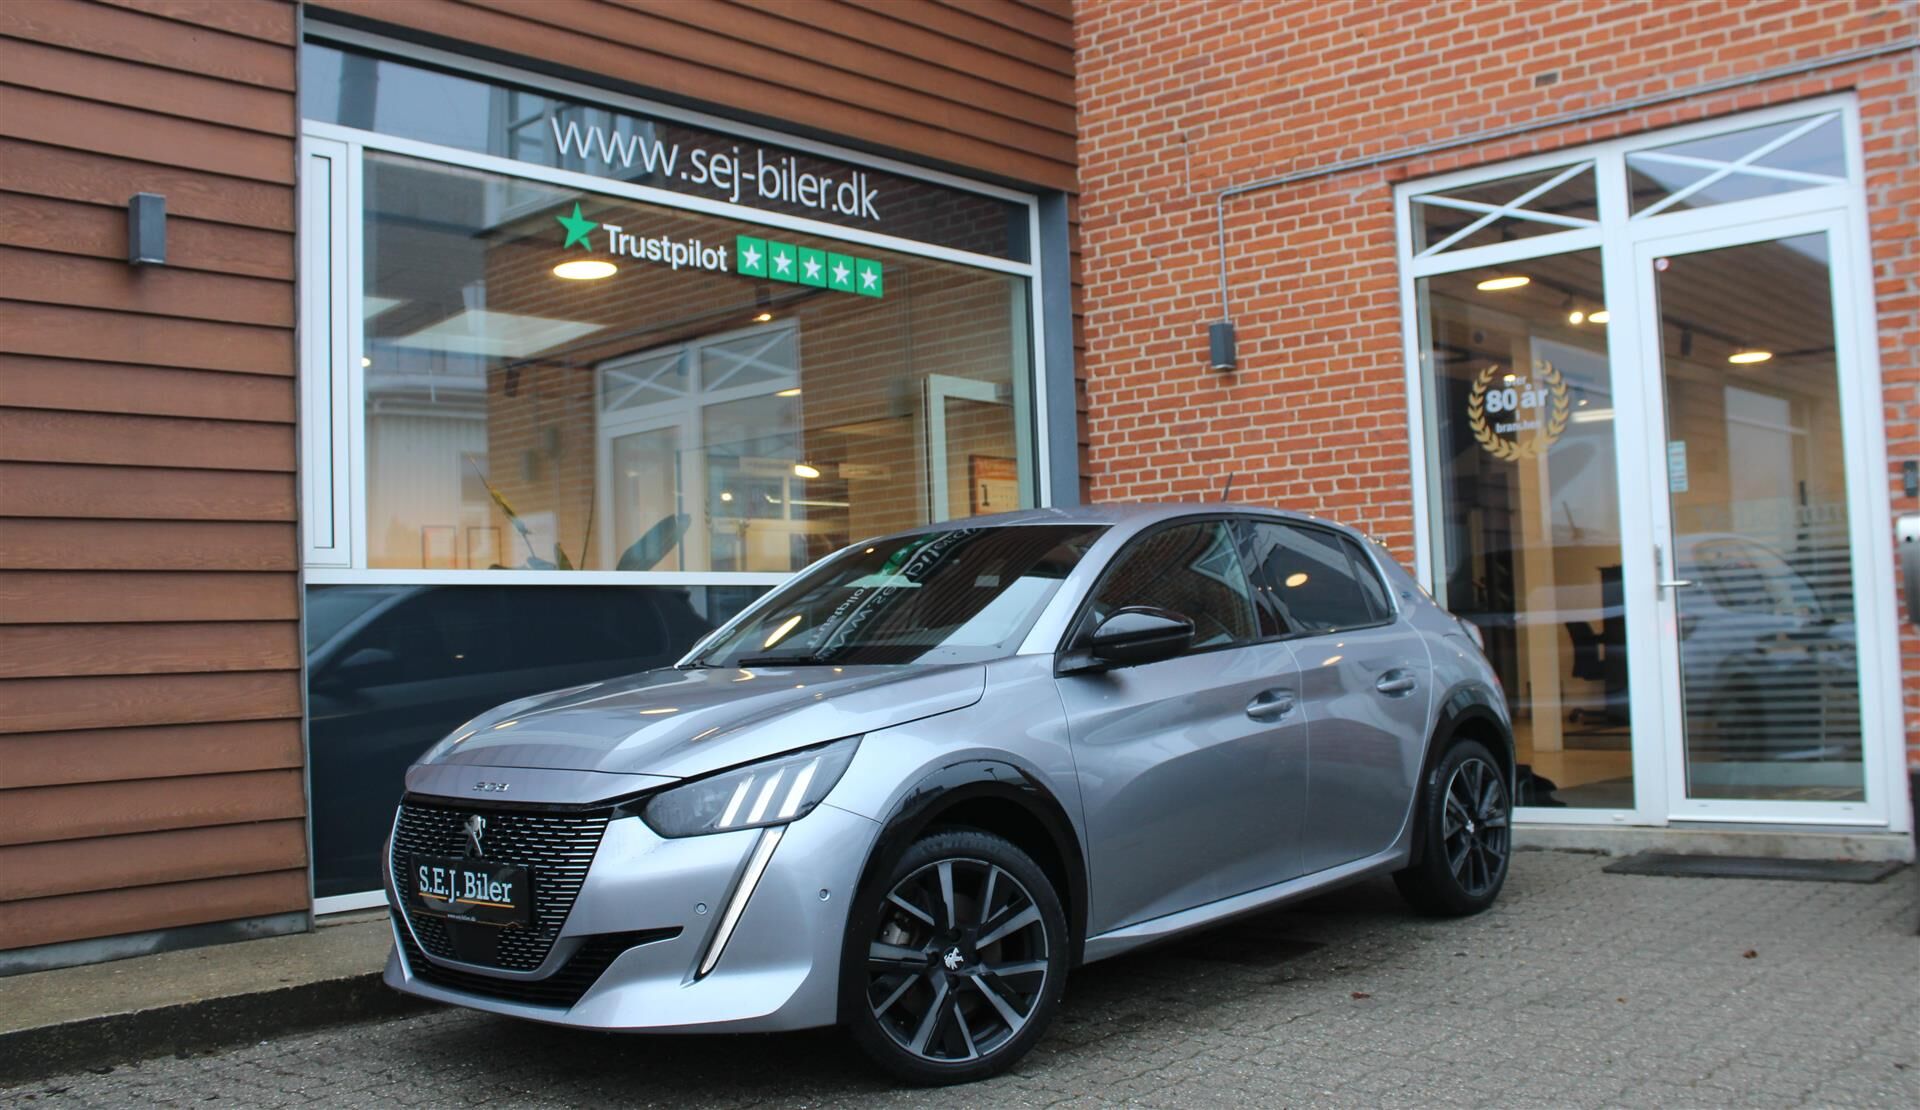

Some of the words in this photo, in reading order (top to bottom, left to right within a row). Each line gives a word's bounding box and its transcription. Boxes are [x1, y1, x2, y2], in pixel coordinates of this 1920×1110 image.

[551, 117, 881, 221] www.sej-biler.dk
[602, 223, 728, 272] Trustpilot
[1485, 388, 1518, 413] 80
[1521, 383, 1549, 408] år
[419, 865, 460, 903] S.E.J.
[463, 871, 512, 903] Biler
